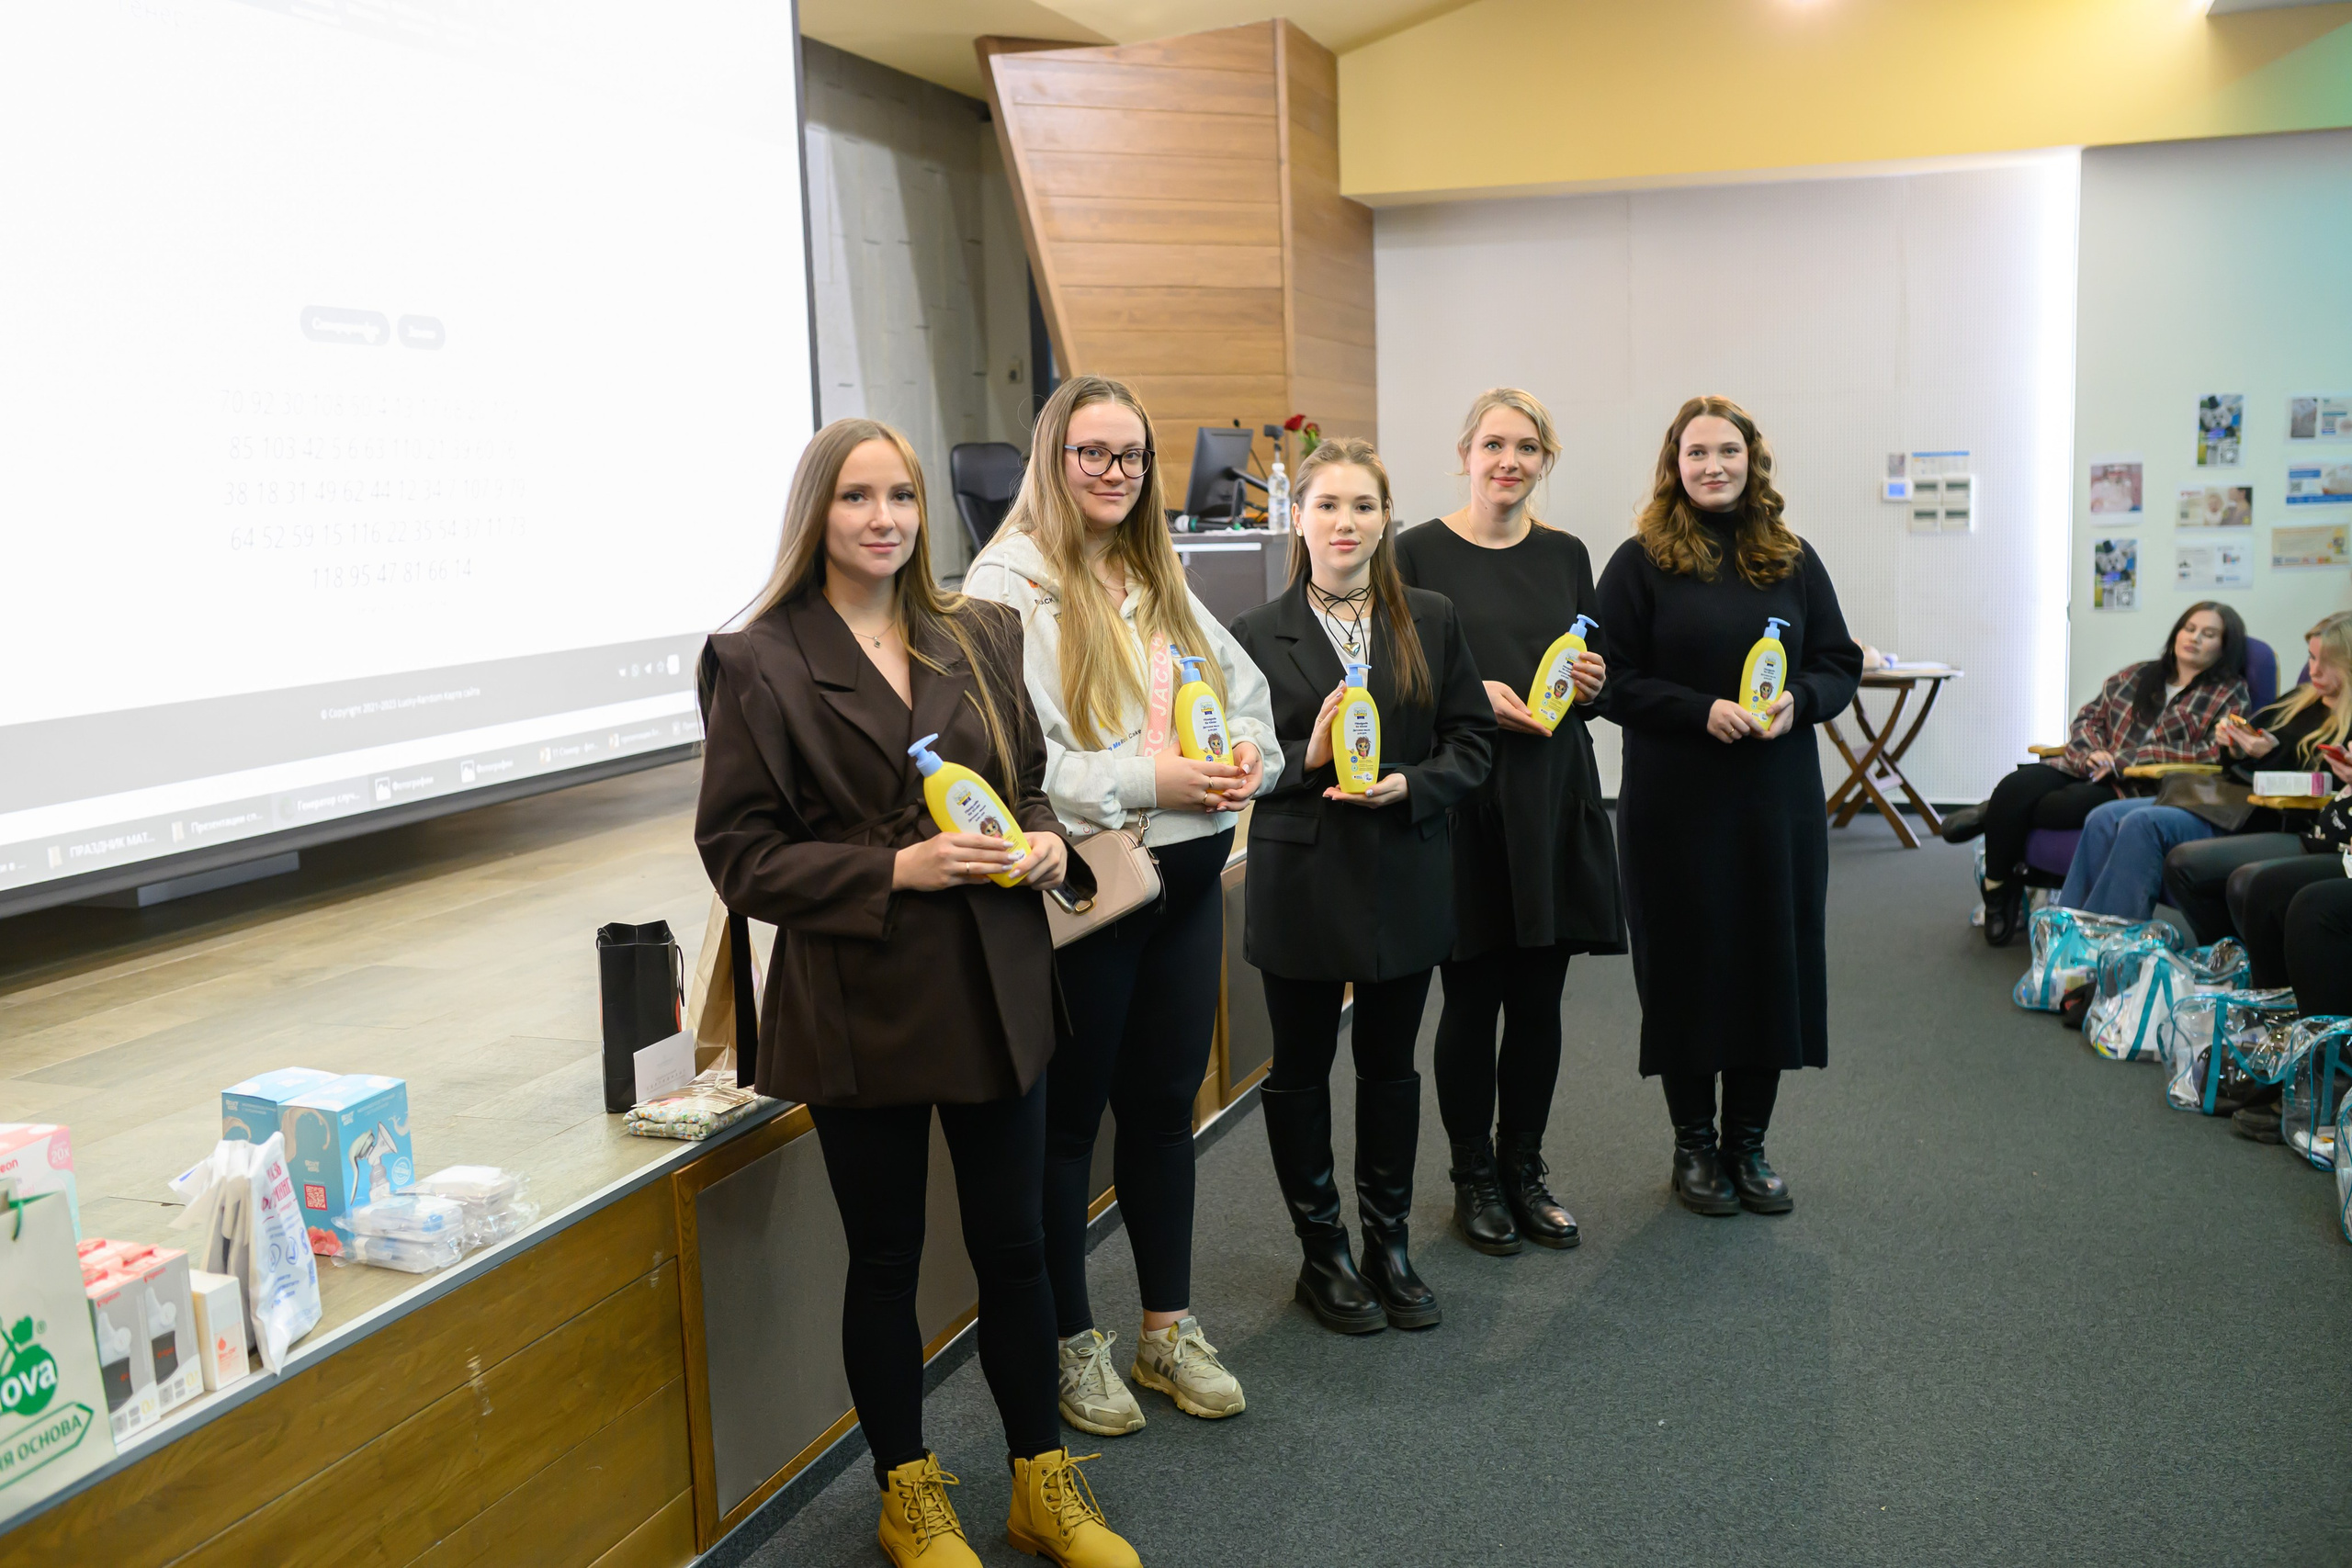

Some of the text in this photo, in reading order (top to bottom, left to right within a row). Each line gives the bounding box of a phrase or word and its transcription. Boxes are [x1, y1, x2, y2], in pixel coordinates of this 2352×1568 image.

[220, 389, 243, 413] 70
[252, 391, 274, 414] 92
[284, 392, 303, 414] 30
[230, 436, 254, 459] 85
[264, 436, 296, 459] 103
[303, 437, 323, 459] 42
[333, 438, 341, 459] 5
[348, 438, 358, 459] 6
[365, 438, 384, 459] 63
[393, 439, 421, 459] 110
[427, 439, 444, 459] 21
[224, 482, 248, 505] 38
[257, 482, 278, 504] 18
[286, 481, 306, 504] 31
[315, 481, 336, 502] 49
[344, 480, 364, 502] 62
[370, 480, 390, 501] 44
[399, 479, 415, 501] 12
[423, 479, 441, 501] 34
[448, 479, 456, 499] 7
[464, 479, 489, 499] 107
[495, 479, 503, 499] 9
[231, 516, 526, 550] 64 52 59 15 116 22 35 54 37 11 73
[312, 558, 472, 589] 118 95 47 81 66 14
[329, 705, 362, 718] Copyright
[363, 699, 396, 713] 2021-2023
[69, 836, 124, 858] ПРАЗДНИК
[17, 1415, 82, 1460] ОСНОВА
